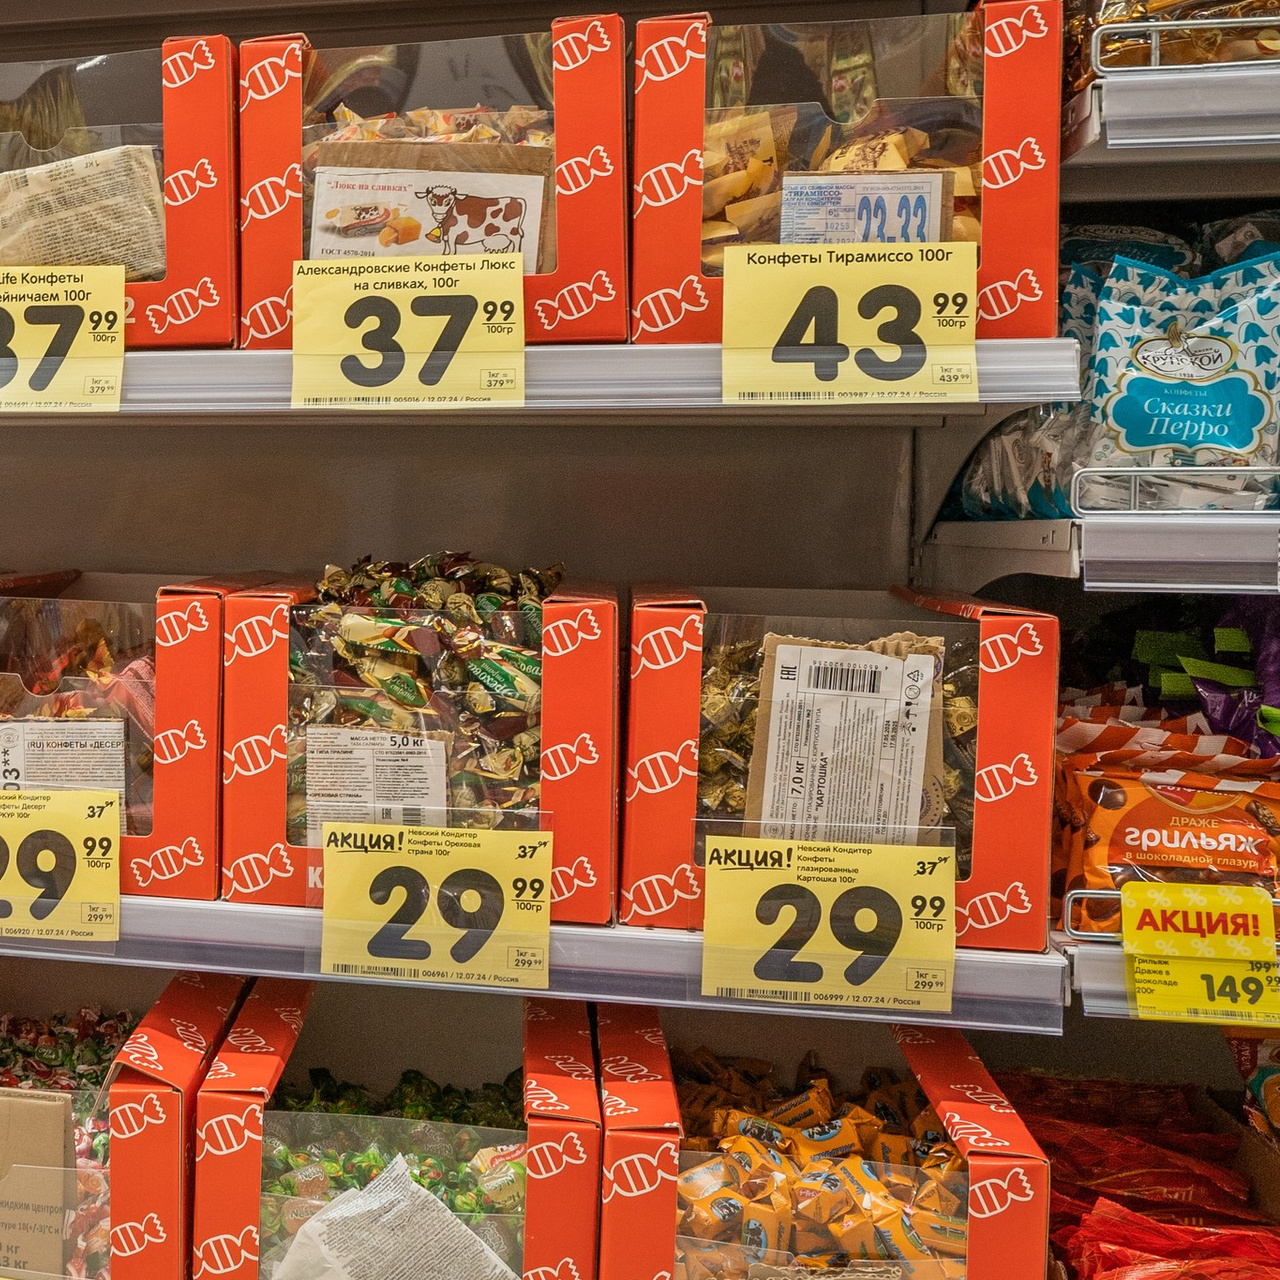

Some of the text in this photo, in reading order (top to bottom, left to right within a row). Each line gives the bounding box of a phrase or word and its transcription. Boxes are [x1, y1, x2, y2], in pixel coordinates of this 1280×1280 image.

[747, 249, 953, 267] Конфеты Тирамиссо 100г
[297, 260, 516, 277] Александровские Конфеты Люкс
[21, 272, 84, 286] Конфеты
[354, 278, 460, 291] на сливках, 100г
[64, 290, 92, 302] 100г
[771, 285, 968, 382] 43 99
[1144, 397, 1232, 418] Сказки
[1148, 418, 1229, 441] Перро
[1170, 817, 1219, 828] ДРАЖЕ
[327, 831, 404, 853] АКЦИЯ!
[408, 839, 442, 847] Конфеты
[797, 844, 872, 856] Невский Кондитер
[1136, 853, 1212, 864] шоколадной
[797, 875, 856, 884] Картошка 100г
[367, 866, 544, 963] 29 99
[1137, 909, 1259, 938] АКЦИЯ!
[1134, 979, 1178, 987] шоколаде
[1201, 974, 1263, 1004] 149
[814, 993, 844, 1001] 006999
[852, 996, 884, 1004] 12.07.24
